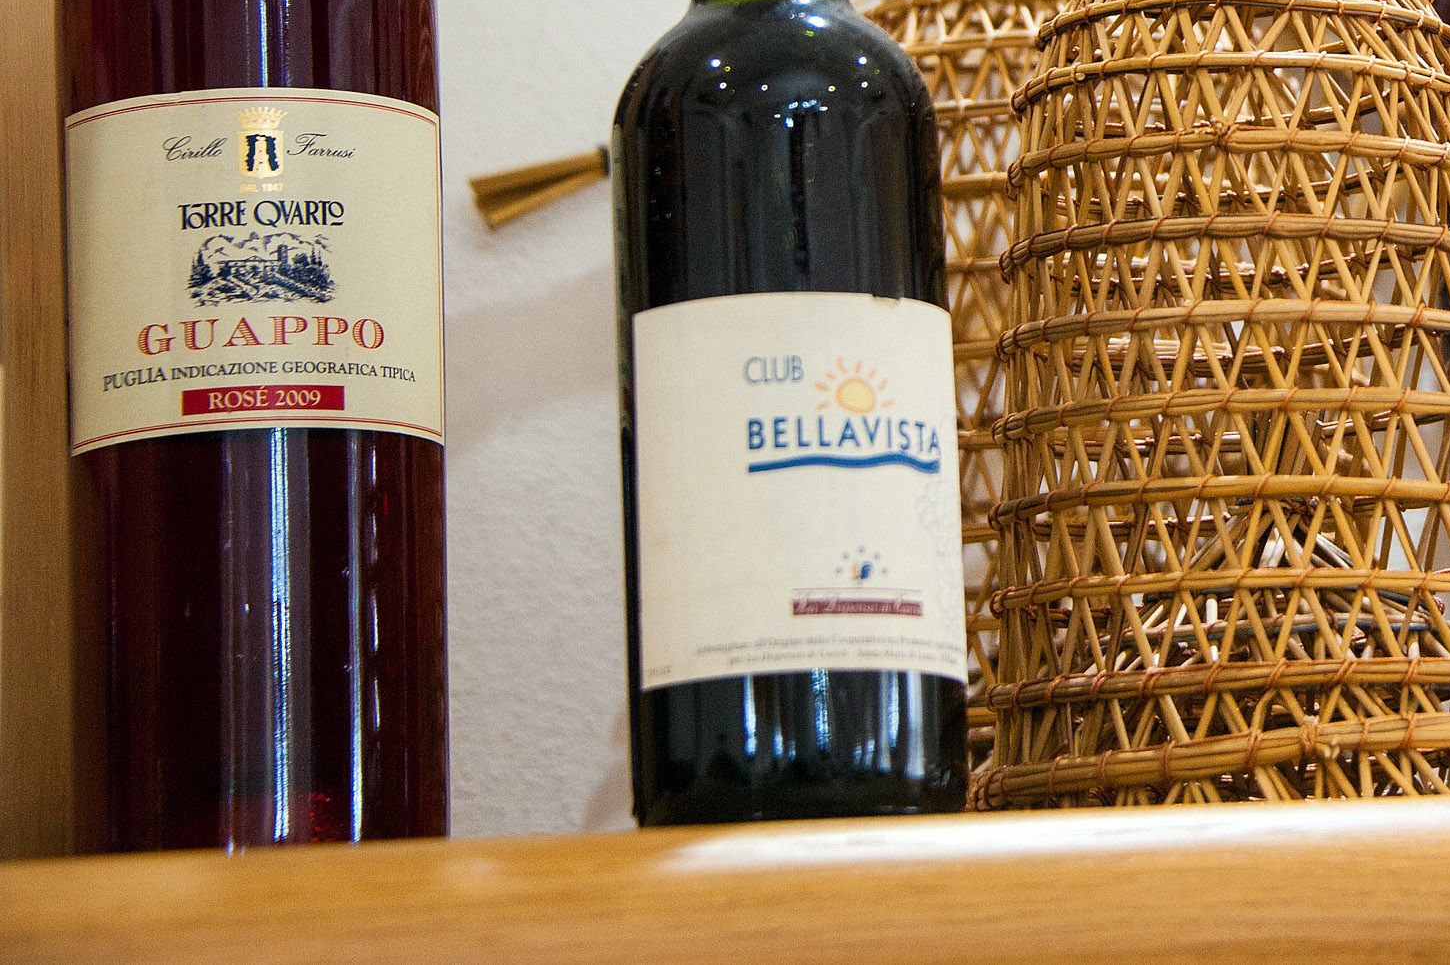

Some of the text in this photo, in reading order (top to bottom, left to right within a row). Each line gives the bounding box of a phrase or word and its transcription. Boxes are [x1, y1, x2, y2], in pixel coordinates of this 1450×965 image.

[163, 136, 228, 161] Cirillo
[286, 133, 356, 159] Farrusi
[178, 200, 248, 230] TORRE
[137, 315, 385, 356] GUAPPO
[103, 360, 417, 392] PUGLIA INDICAZIONE GEOGRAFICA TIPICA
[745, 354, 804, 384] CLUB
[208, 385, 322, 411] ROSÉ 2009
[748, 414, 942, 456] BELLAVISTA
